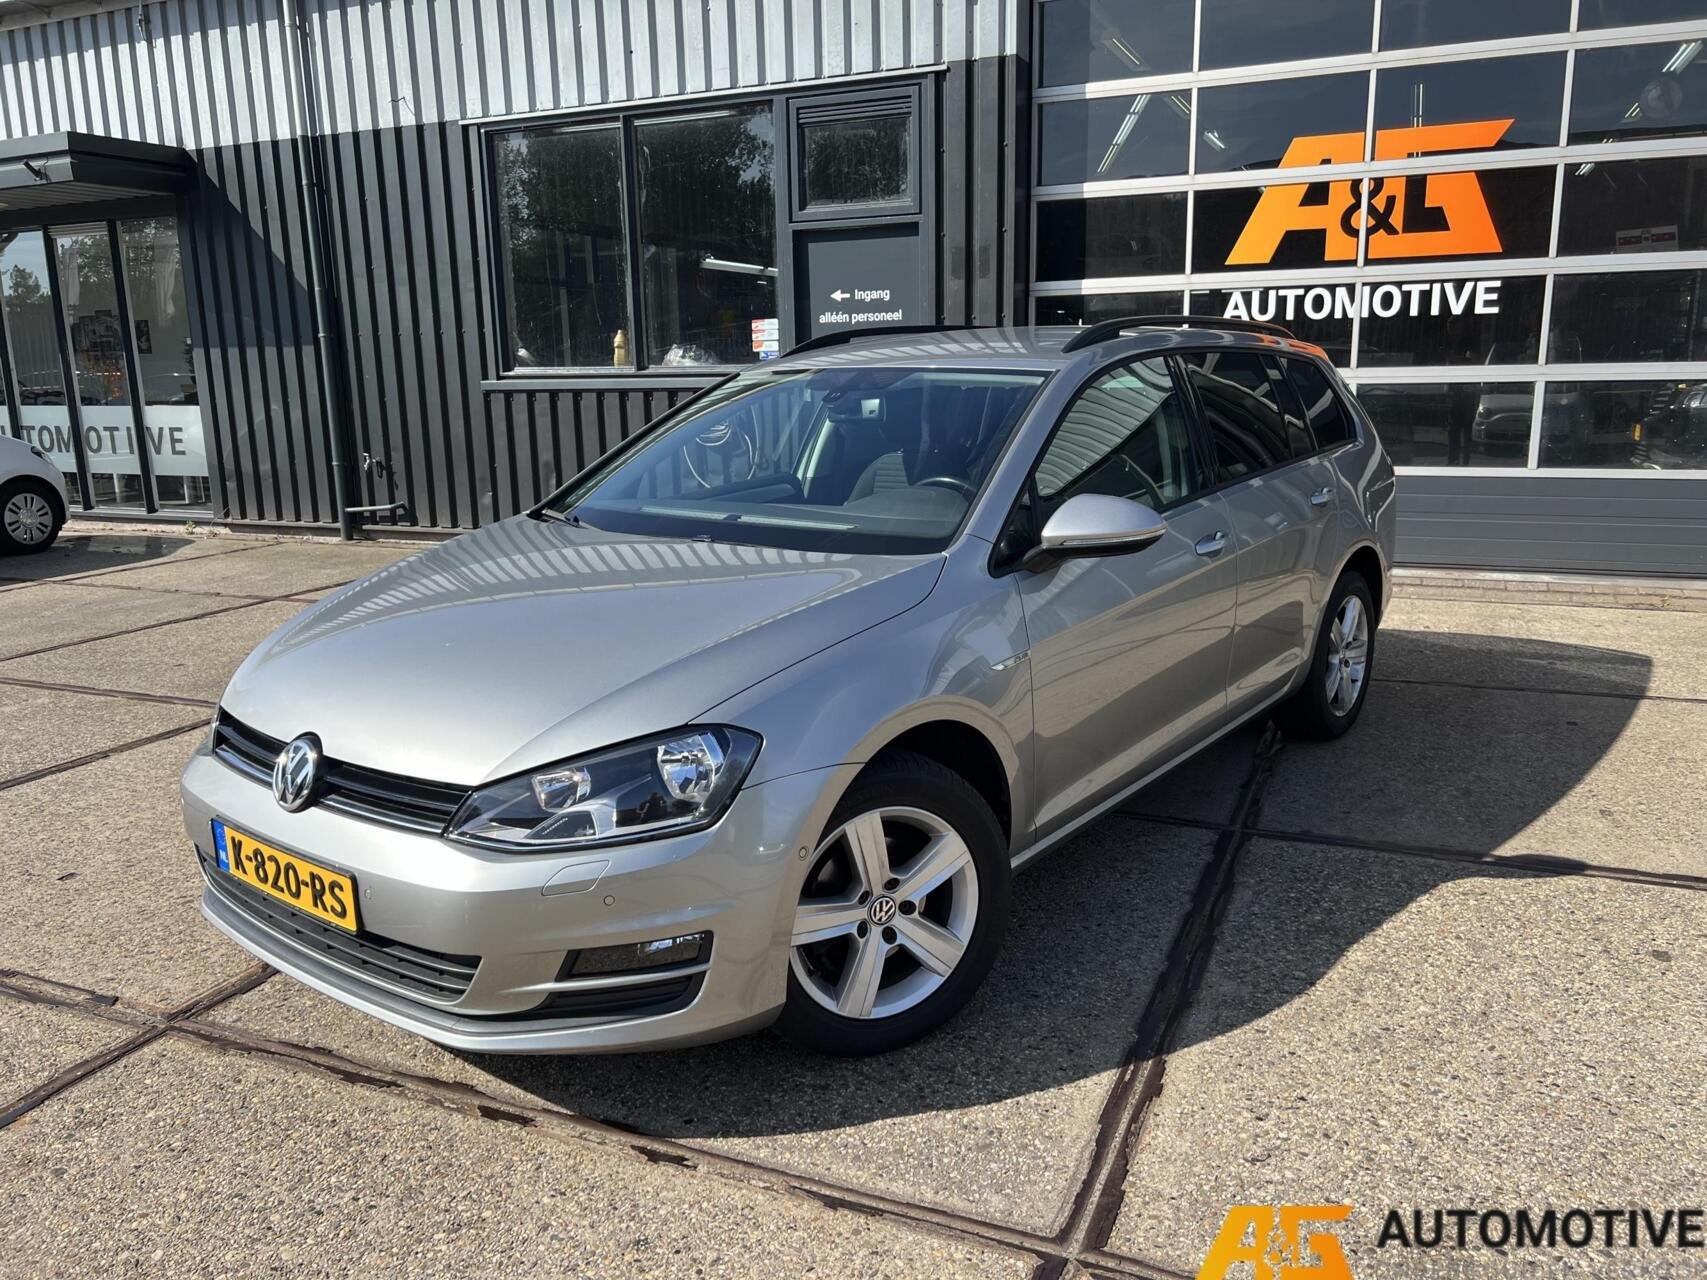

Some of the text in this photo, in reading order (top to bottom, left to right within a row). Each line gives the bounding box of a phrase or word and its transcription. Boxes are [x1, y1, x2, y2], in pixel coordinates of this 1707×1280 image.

[854, 289, 891, 302] Ingang
[1222, 280, 1502, 321] AUTOMOTIVE
[819, 309, 903, 325] alléén personeel
[0, 425, 187, 456] TOMOTIVE
[230, 836, 347, 919] K-820-RS
